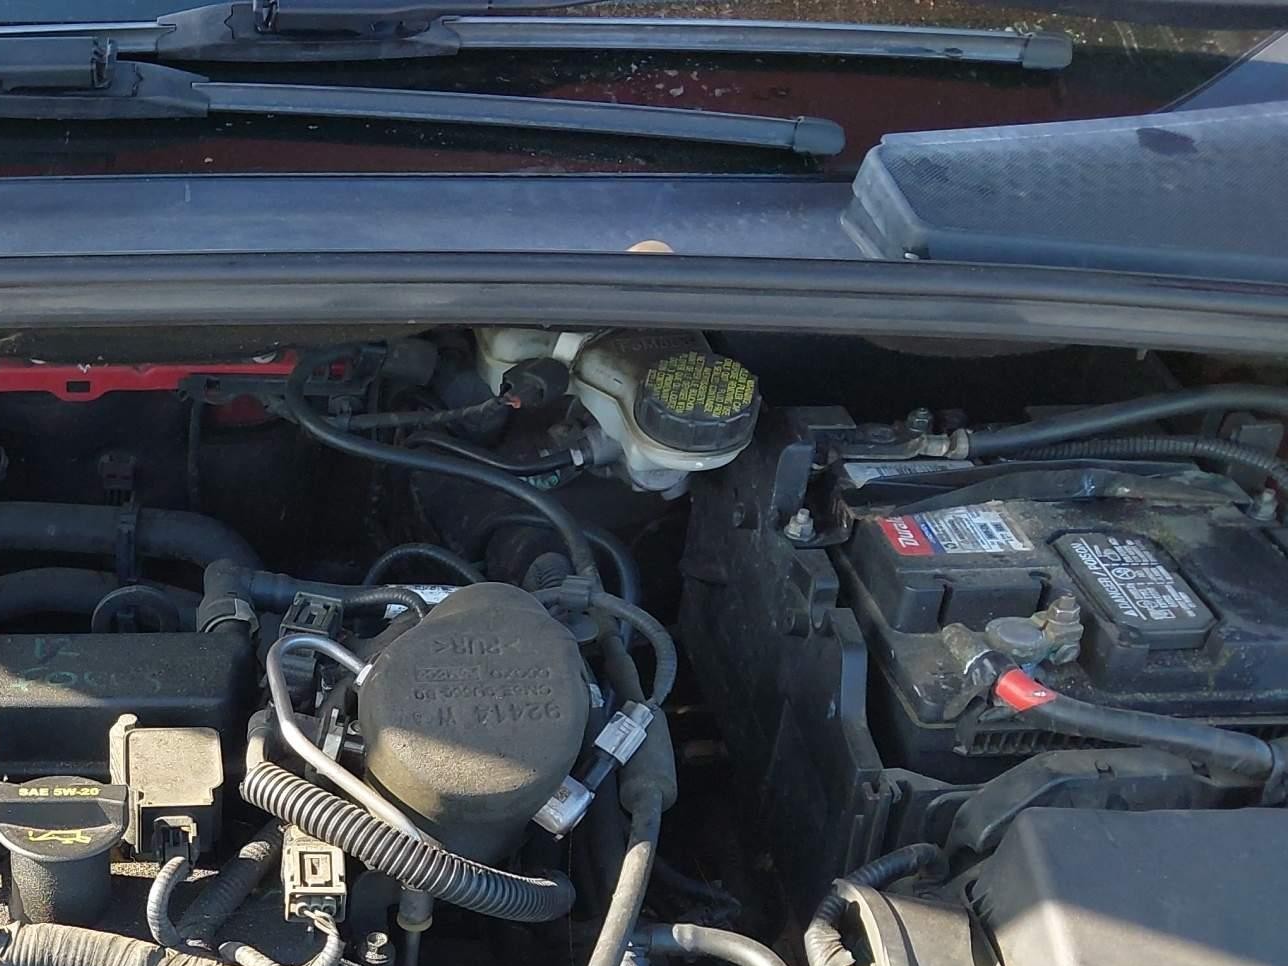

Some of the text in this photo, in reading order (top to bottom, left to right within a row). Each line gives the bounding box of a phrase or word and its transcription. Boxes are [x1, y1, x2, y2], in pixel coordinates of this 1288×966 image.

[1070, 543, 1102, 571] POISON
[1097, 576, 1131, 608] DANGER
[18, 787, 100, 796] SAE 5W-20
